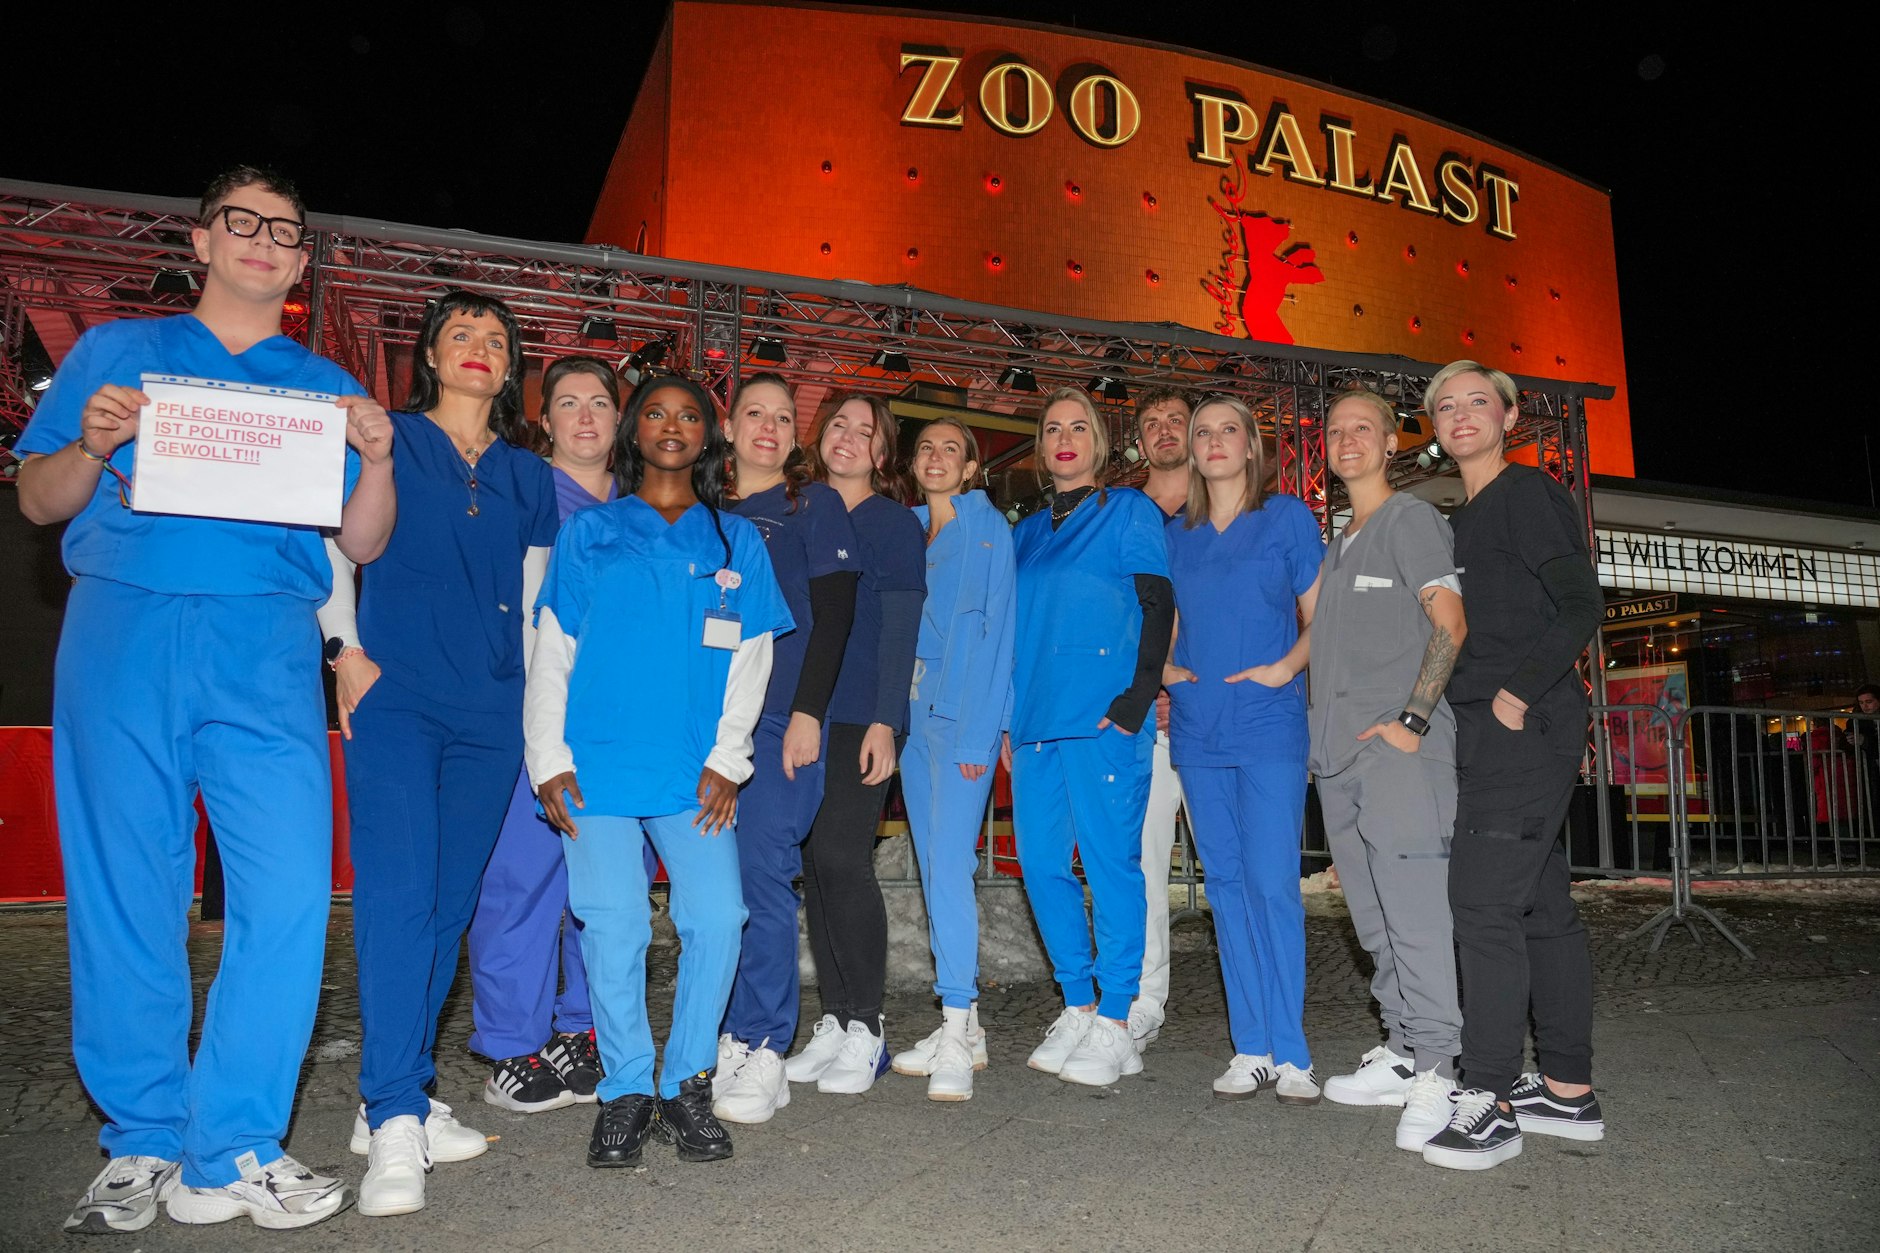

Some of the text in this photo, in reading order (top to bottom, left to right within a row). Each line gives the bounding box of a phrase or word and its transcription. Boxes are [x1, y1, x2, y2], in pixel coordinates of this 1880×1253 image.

[900, 54, 1520, 240] ZOO PALAST
[1206, 157, 1246, 337] erlinale
[156, 402, 324, 433] PFLEGENOTSTAND
[154, 421, 282, 447] IST POLITISCH
[153, 440, 261, 463] GEWOLLT!!!
[1596, 536, 1818, 582] H WILLKOMMEN
[1605, 598, 1671, 619] O PALAST
